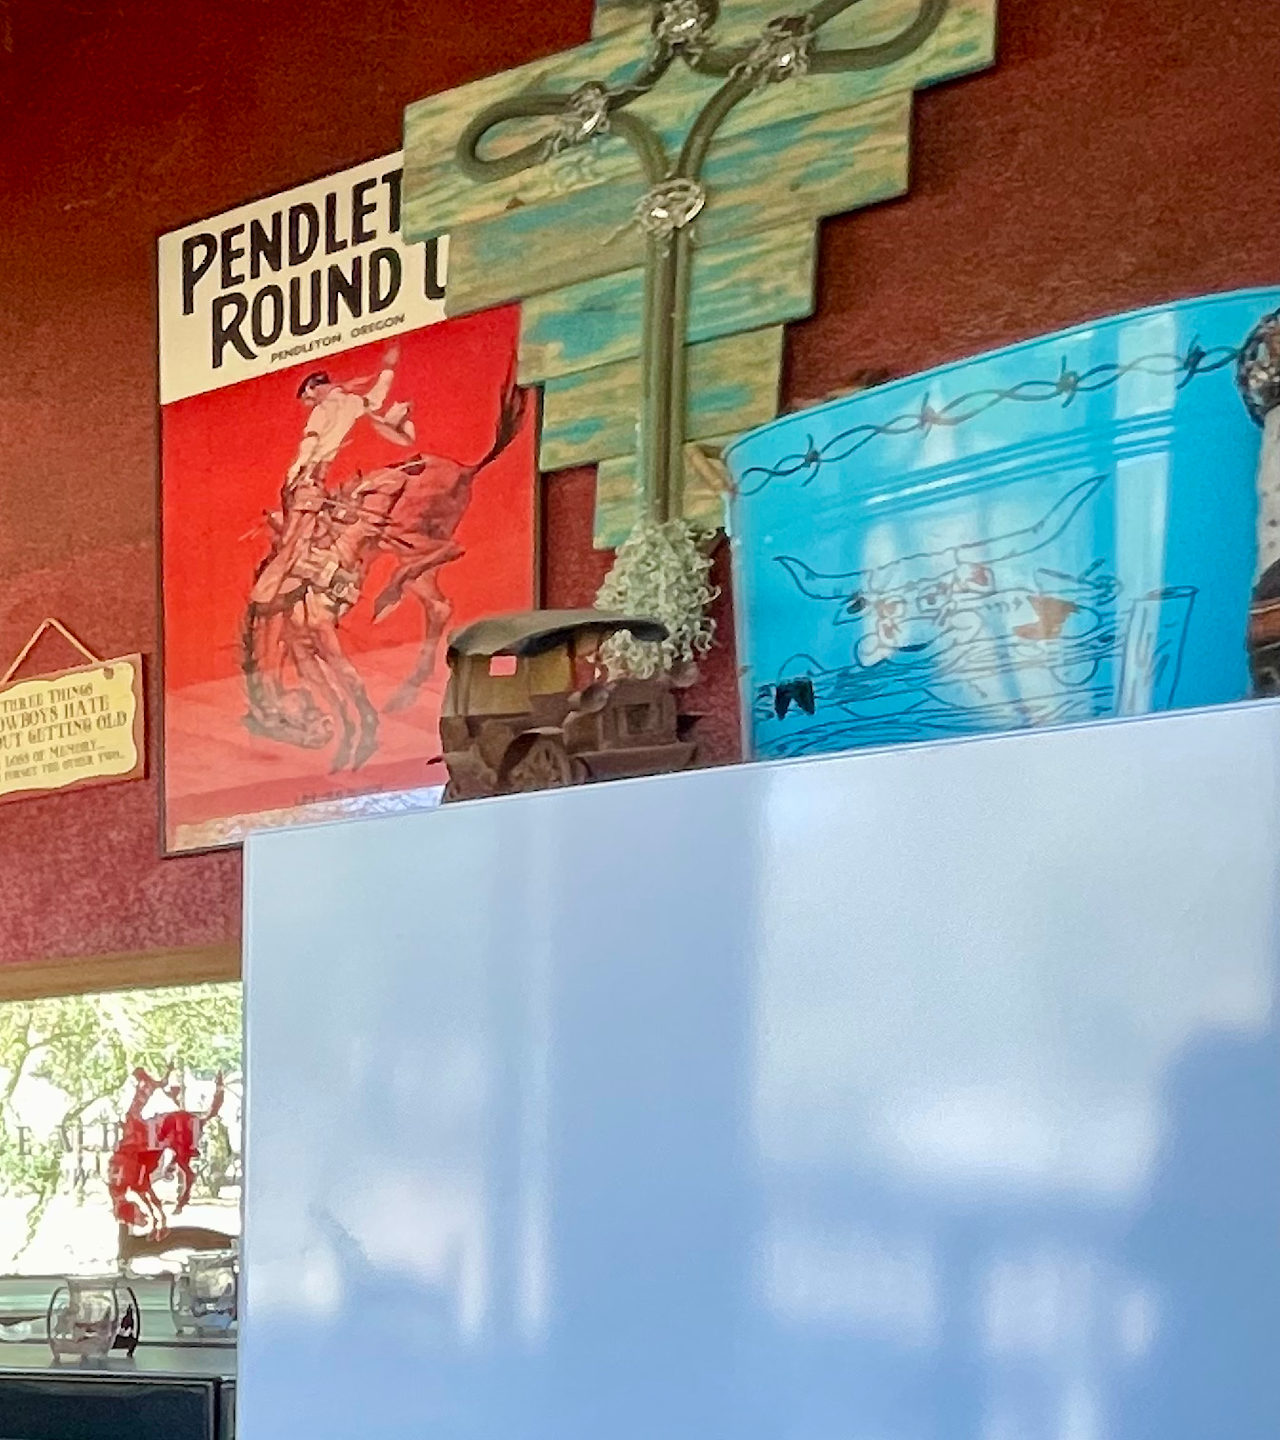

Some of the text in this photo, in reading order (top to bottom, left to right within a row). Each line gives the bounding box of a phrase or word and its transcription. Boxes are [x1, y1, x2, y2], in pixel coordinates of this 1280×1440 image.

[182, 169, 404, 315] PENDLET
[212, 237, 446, 369] ROUND U
[270, 313, 405, 363] PENDLETON OREGON
[0, 682, 93, 714] THREE THINGS
[64, 695, 110, 719] HATE
[28, 719, 92, 744] GETTING
[96, 711, 127, 731] OLD
